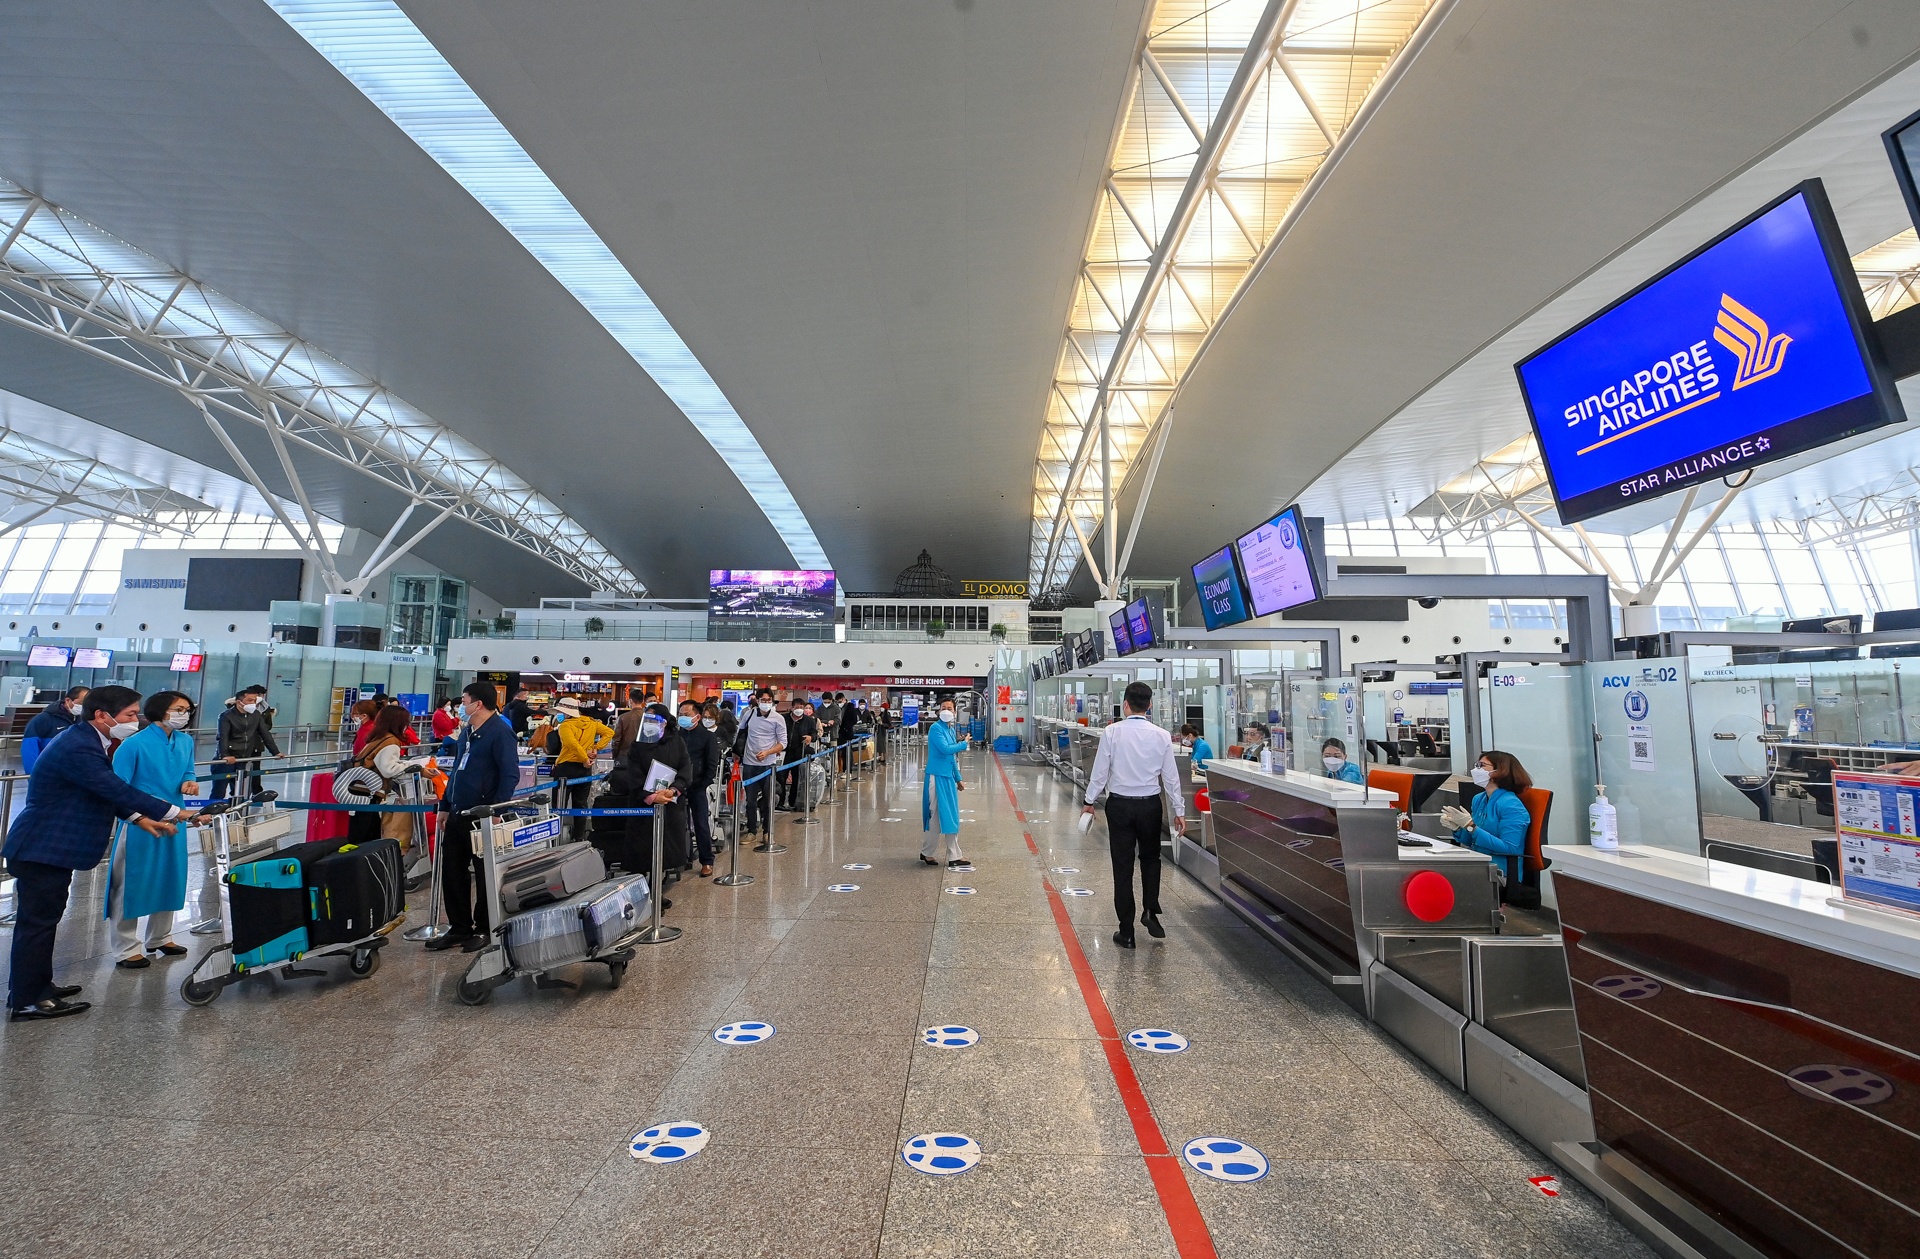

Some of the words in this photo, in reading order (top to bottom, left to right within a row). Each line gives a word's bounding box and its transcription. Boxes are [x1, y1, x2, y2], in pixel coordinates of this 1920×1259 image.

[1564, 339, 1713, 427] SINGAPORE
[1599, 363, 1719, 436] AIRLINES
[1620, 473, 1660, 497] STAR
[1665, 440, 1755, 483] ALLIANCE
[124, 578, 186, 589] SAMSUNG
[965, 583, 976, 592] EL
[978, 583, 1026, 595] DOMO
[1203, 577, 1232, 600] ECONOMY
[1212, 597, 1232, 615] CLASS
[28, 625, 39, 638] A
[393, 655, 416, 663] RECHECK
[894, 677, 925, 685] BURGER
[1493, 675, 1515, 687] E-03
[1602, 675, 1631, 688] ACV
